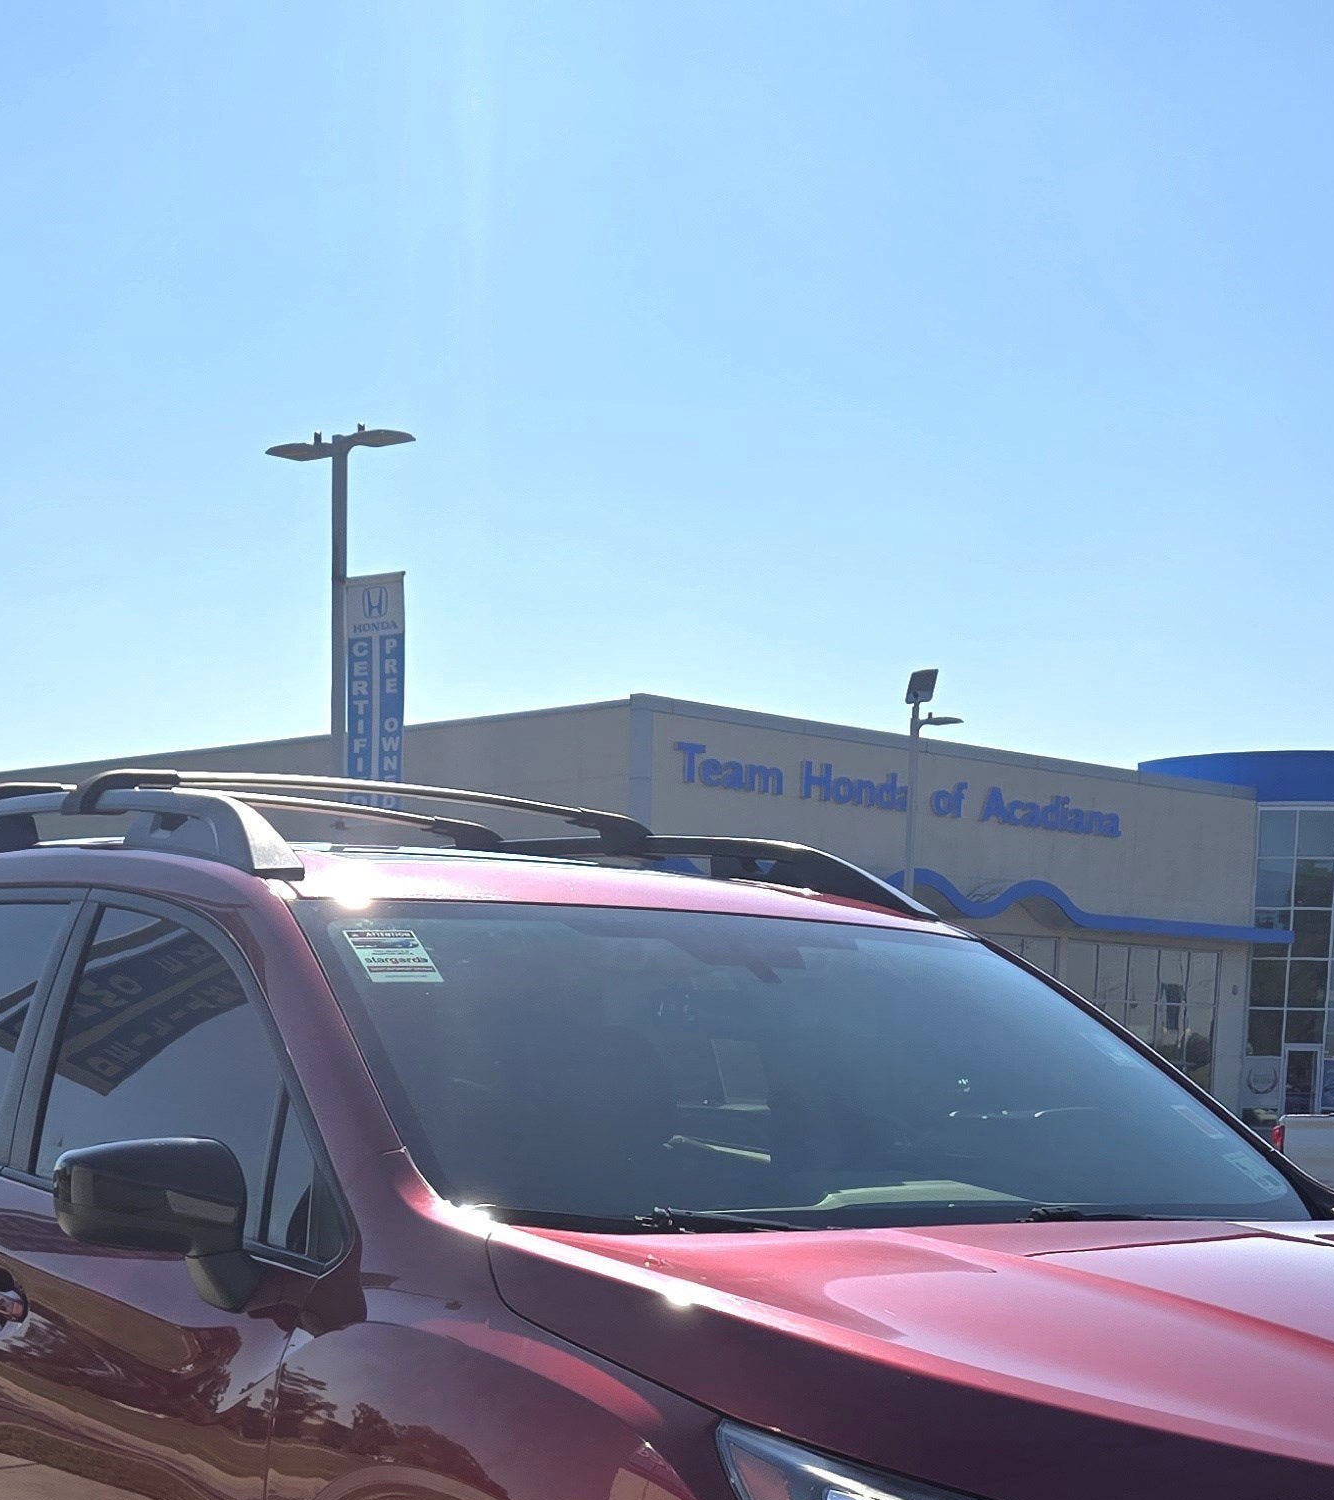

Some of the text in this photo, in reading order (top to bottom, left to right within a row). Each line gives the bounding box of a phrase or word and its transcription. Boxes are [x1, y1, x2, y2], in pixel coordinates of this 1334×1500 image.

[353, 620, 398, 634] HONDA
[384, 638, 399, 694] PRE
[351, 640, 369, 800] CERTIFI
[674, 741, 784, 796] Team
[931, 782, 969, 818] of
[978, 786, 1122, 838] Acadiana
